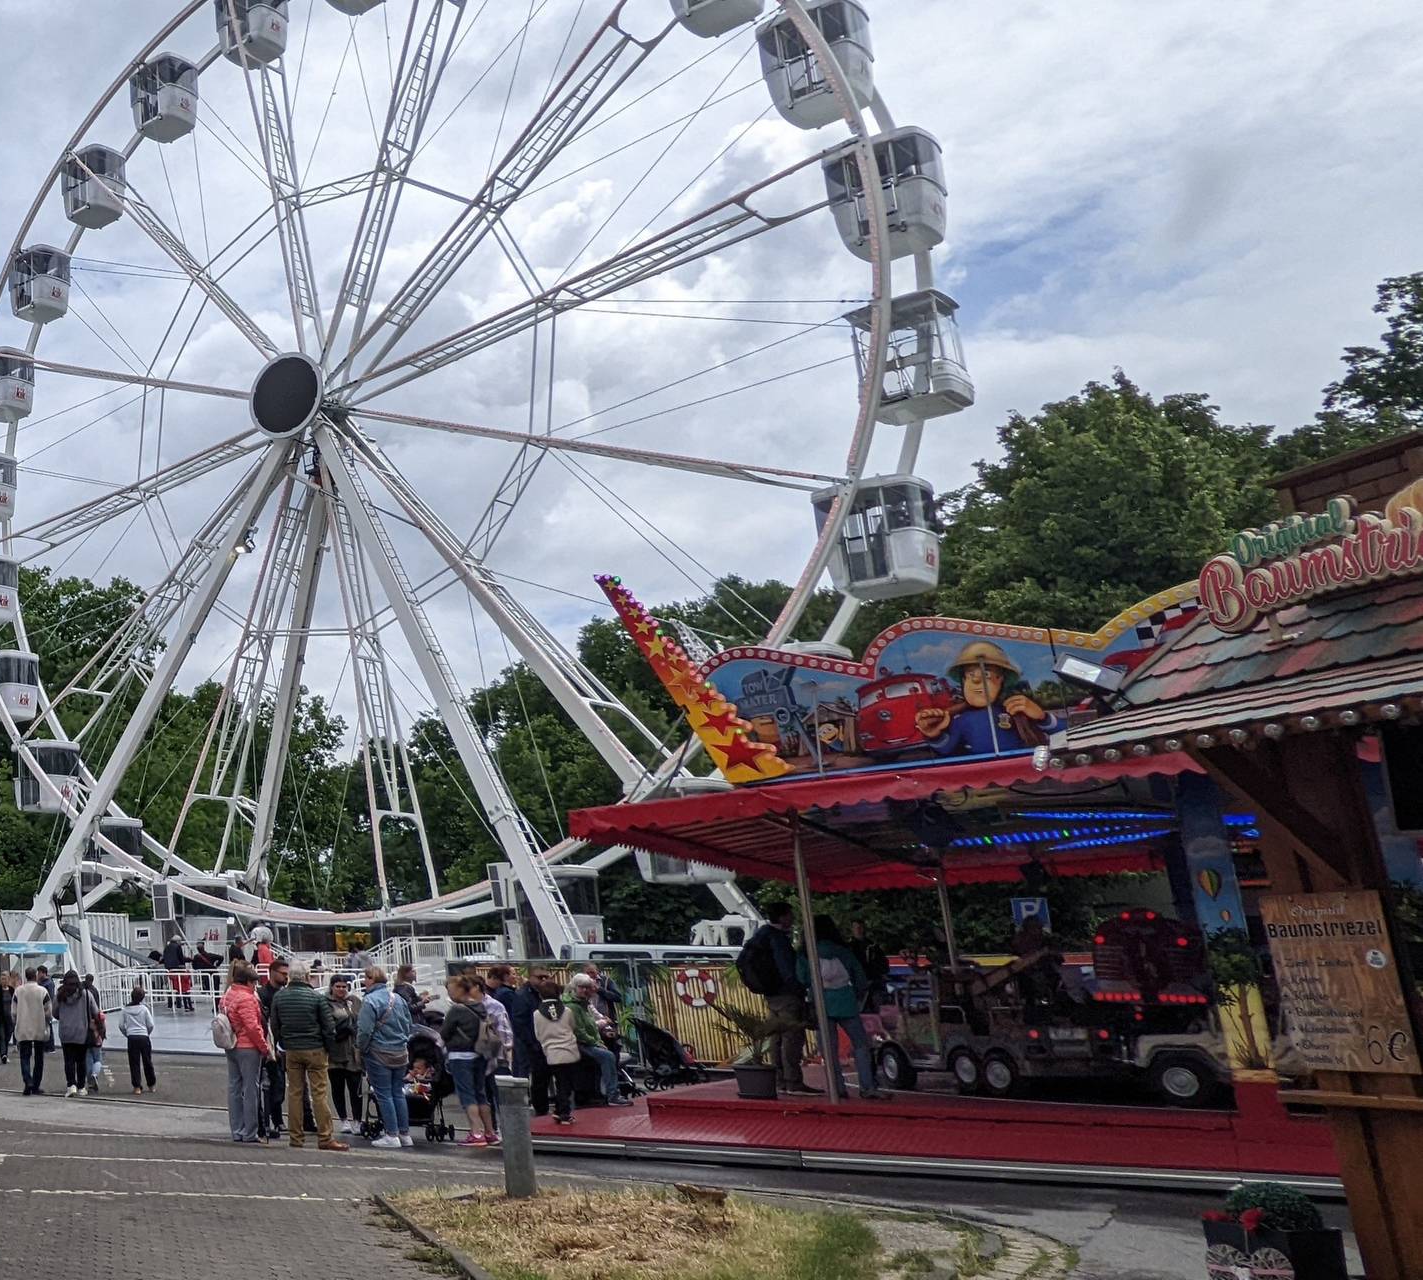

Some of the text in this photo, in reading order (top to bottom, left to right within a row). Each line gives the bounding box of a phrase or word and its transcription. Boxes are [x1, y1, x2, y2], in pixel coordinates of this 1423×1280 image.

[51, 285, 62, 298] kik
[15, 387, 26, 400] kik
[1231, 498, 1349, 567] Original
[1199, 514, 1423, 627] Baumstri
[19, 693, 29, 707] kik
[1020, 900, 1040, 920] P
[1266, 918, 1383, 939] Baumstriezel
